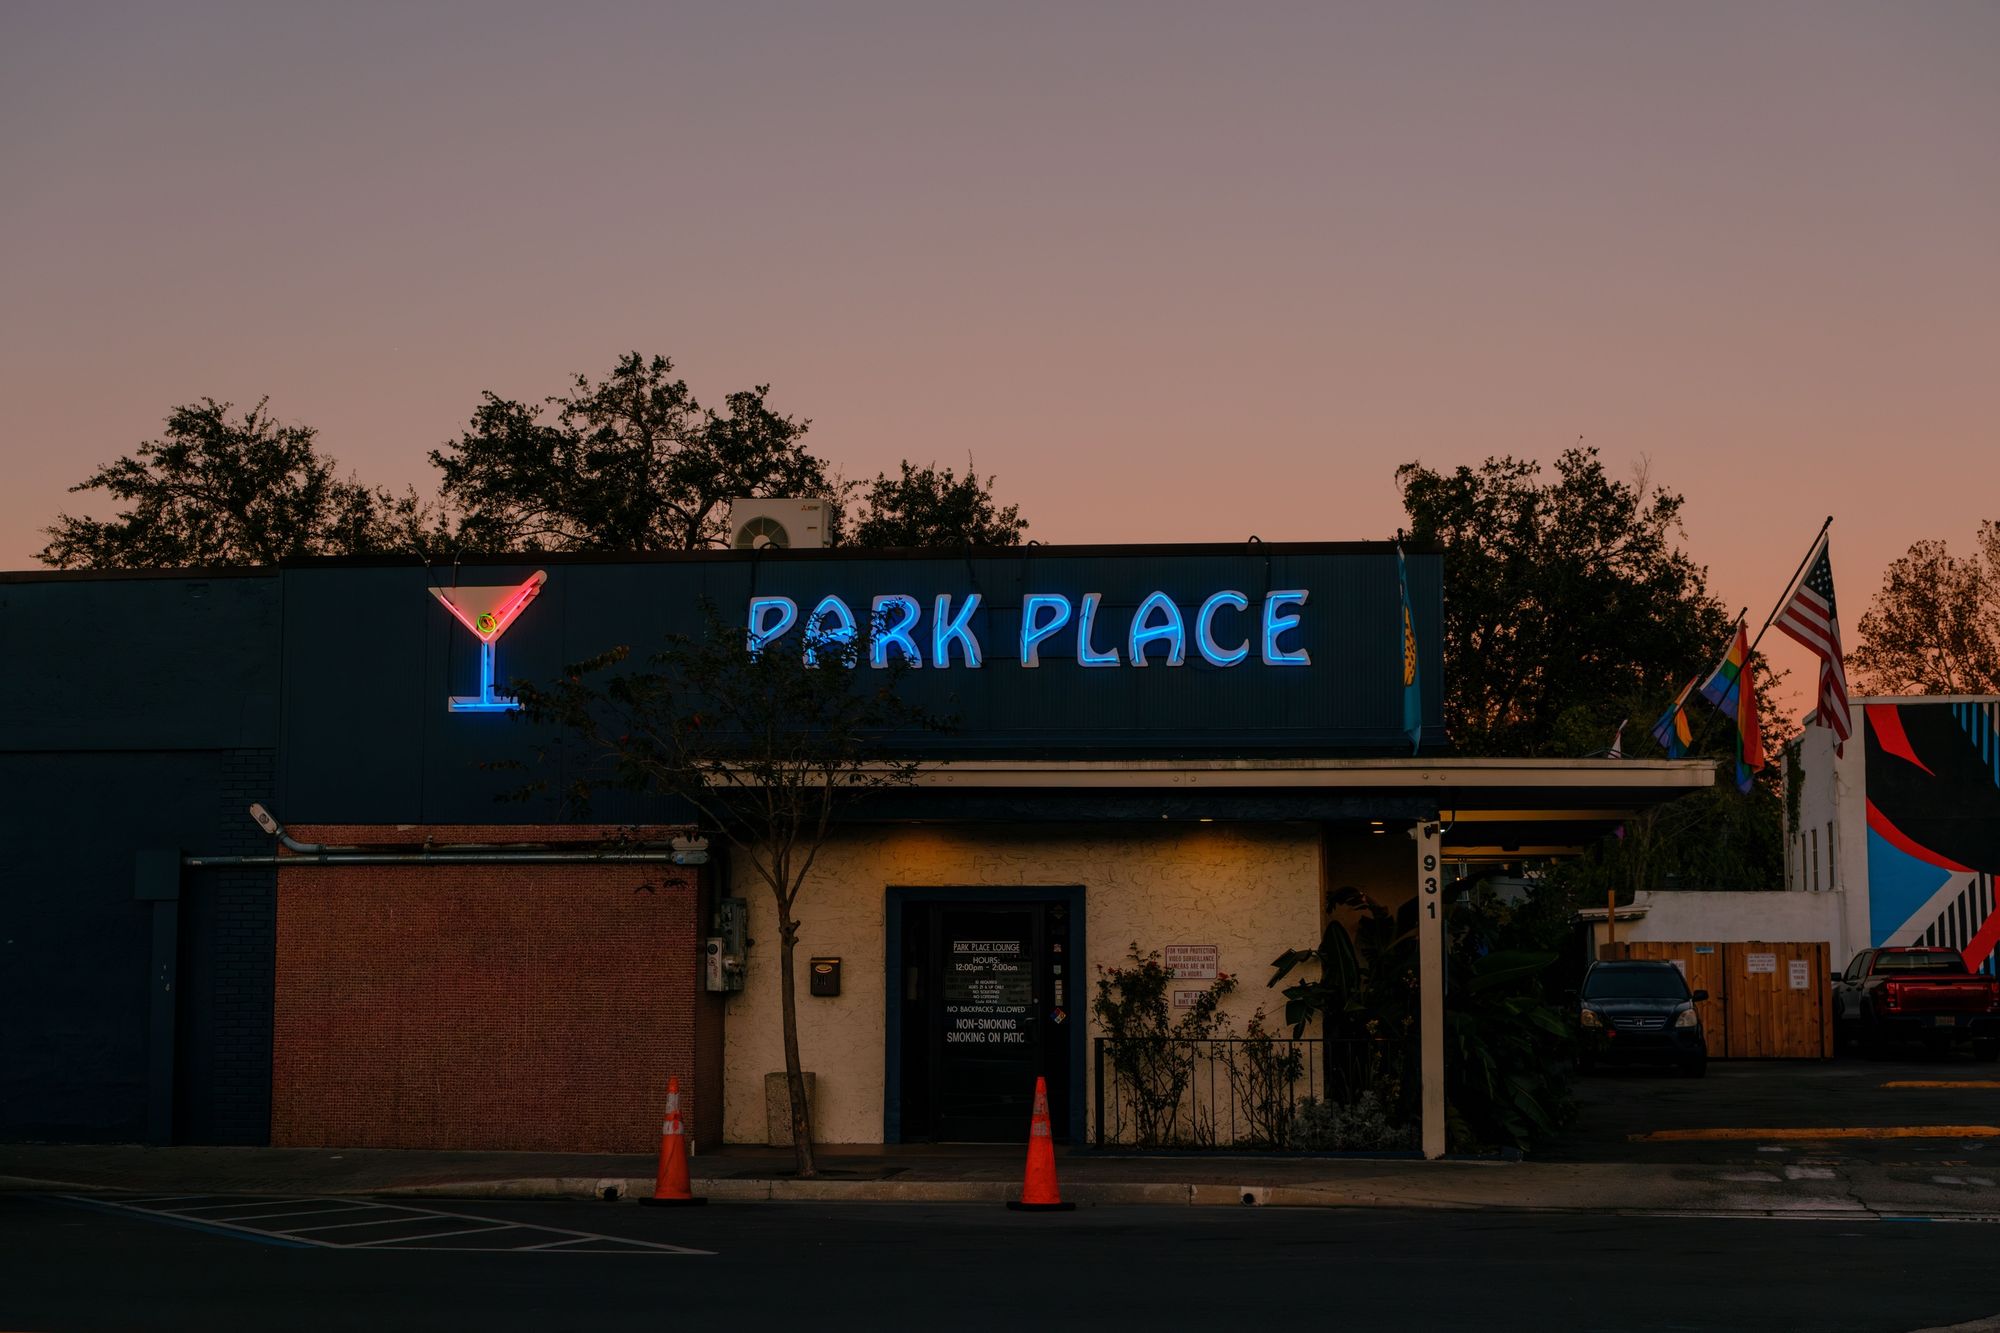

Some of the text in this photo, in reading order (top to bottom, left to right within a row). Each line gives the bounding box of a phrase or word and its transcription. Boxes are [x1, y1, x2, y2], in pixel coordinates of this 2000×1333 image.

[746, 590, 1312, 669] PARK PLACE
[1424, 855, 1437, 919] 931
[953, 943, 1021, 951] PARK PLACE LOUNGE
[973, 956, 1001, 964] HOURS:
[955, 964, 984, 973] 12:00pm
[956, 1018, 1016, 1030] NON-SMOKING
[947, 1032, 985, 1043] SMOKING
[988, 1032, 1001, 1043] ON
